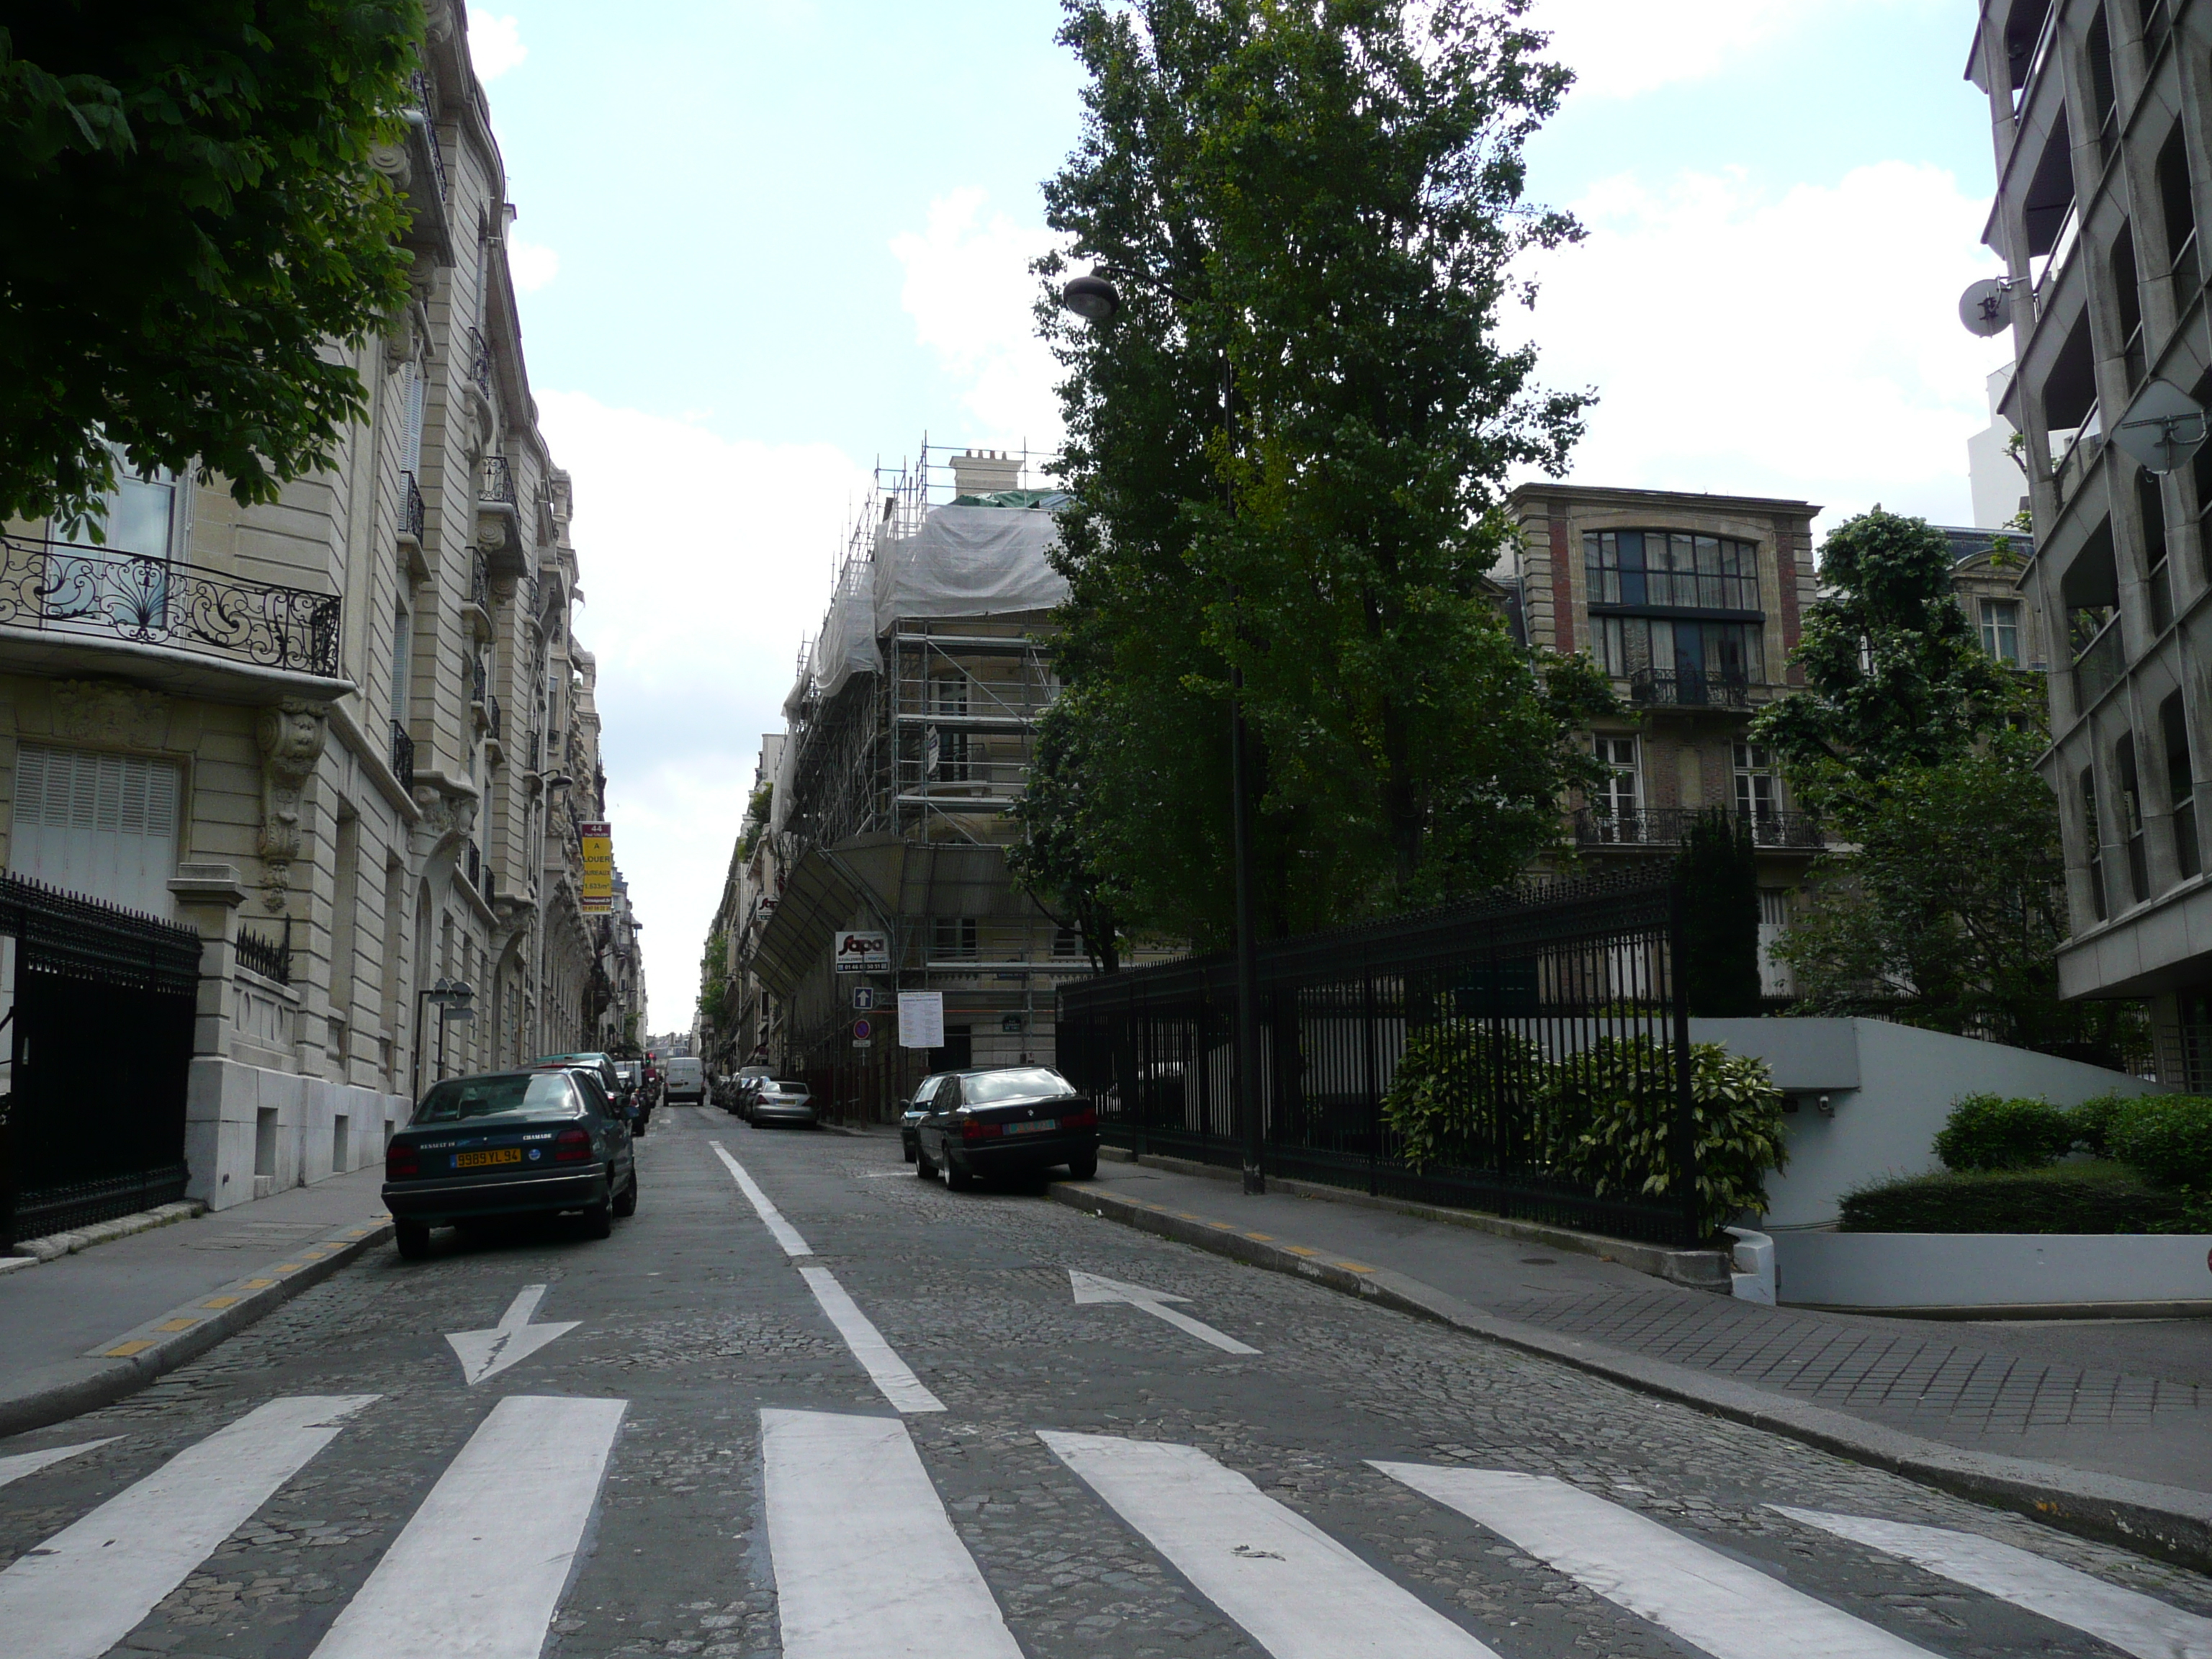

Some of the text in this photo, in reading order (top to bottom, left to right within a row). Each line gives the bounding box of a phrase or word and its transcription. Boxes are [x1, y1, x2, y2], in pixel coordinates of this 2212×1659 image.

[458, 1150, 518, 1166] 9989 YL 94
